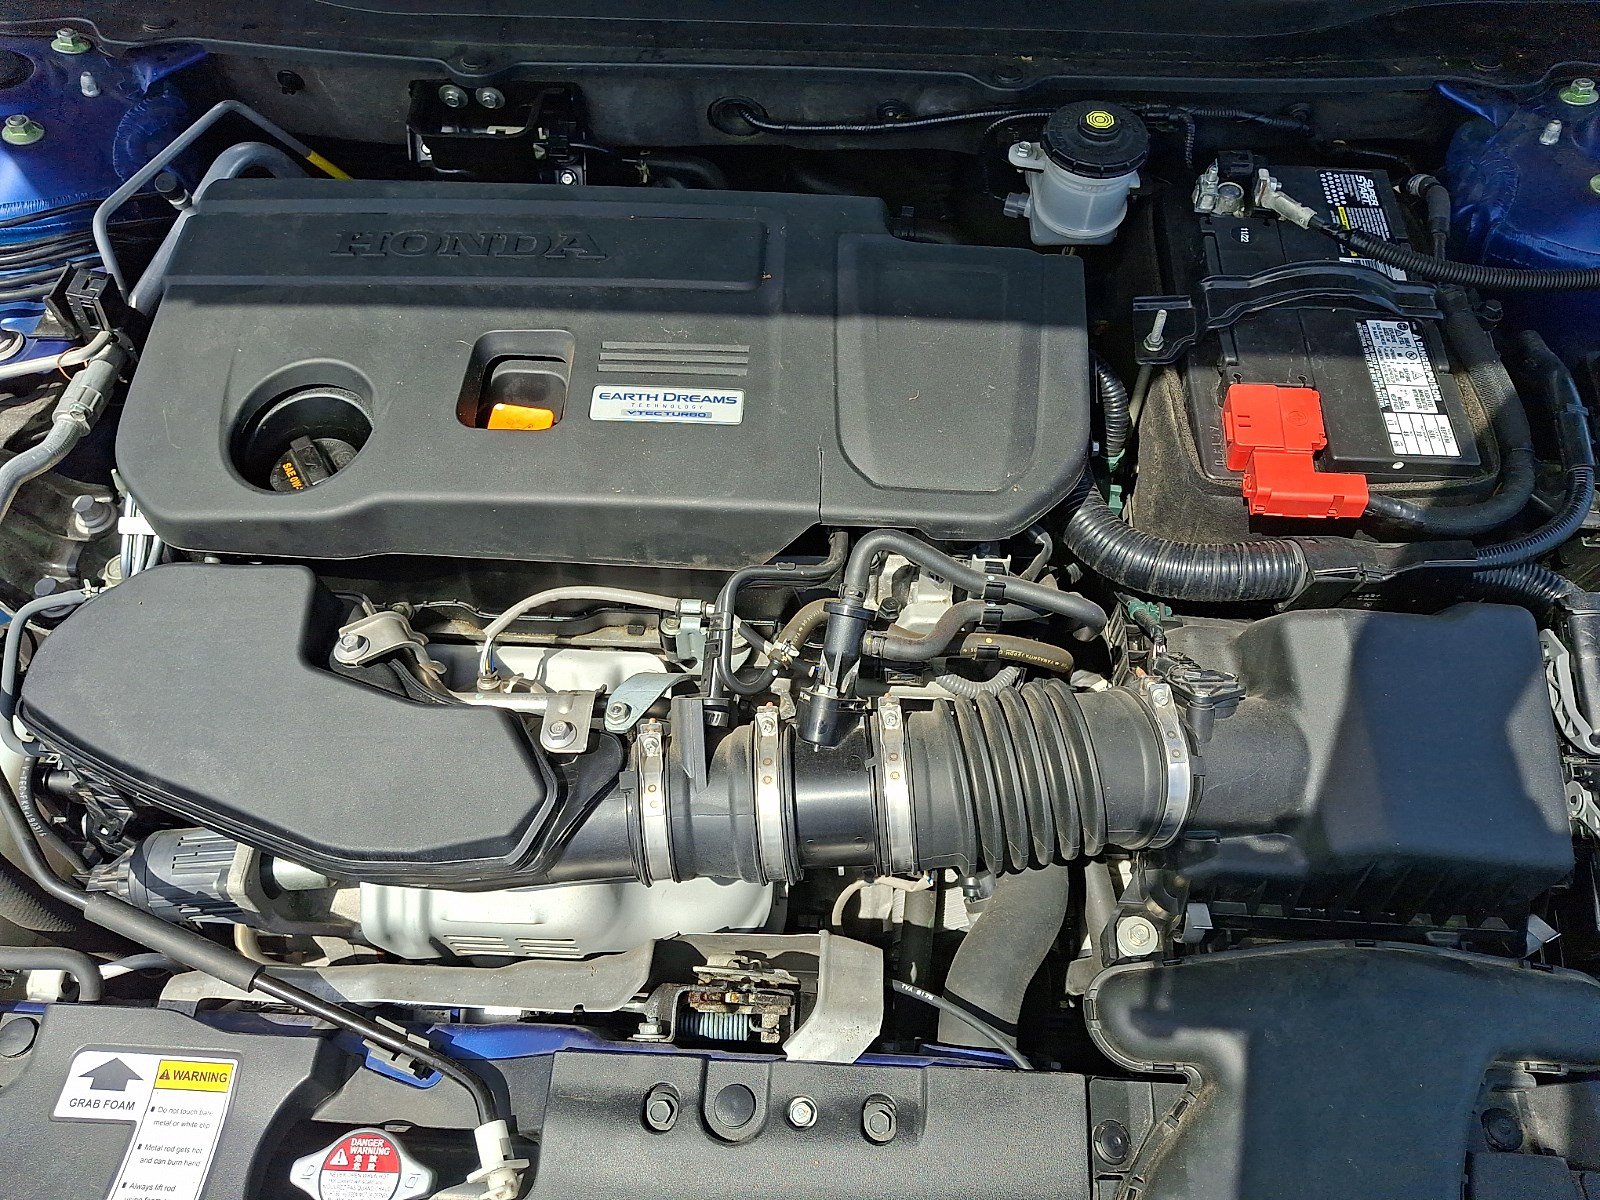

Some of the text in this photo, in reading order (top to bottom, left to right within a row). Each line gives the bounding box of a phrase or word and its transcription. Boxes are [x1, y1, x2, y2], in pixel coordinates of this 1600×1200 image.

[1355, 174, 1371, 206] START
[1364, 178, 1380, 207] SUPER
[330, 229, 607, 260] HONDA
[598, 392, 738, 405] EARTH DREAMS
[631, 402, 704, 410] TECHNOLOGY
[282, 462, 297, 478] SAE
[173, 1069, 228, 1083] WARNING
[69, 1098, 136, 1111] GRAB FOAM
[158, 1106, 168, 1114] Do
[180, 1108, 198, 1116] touch
[153, 1119, 173, 1127] metal
[351, 1137, 385, 1147] DANGER
[144, 1143, 163, 1152] Metal
[176, 1146, 191, 1155] gets
[350, 1146, 391, 1156] WARNUNG
[167, 1158, 183, 1166] burn
[129, 1182, 154, 1192] Always
[154, 1183, 164, 1191] lift
